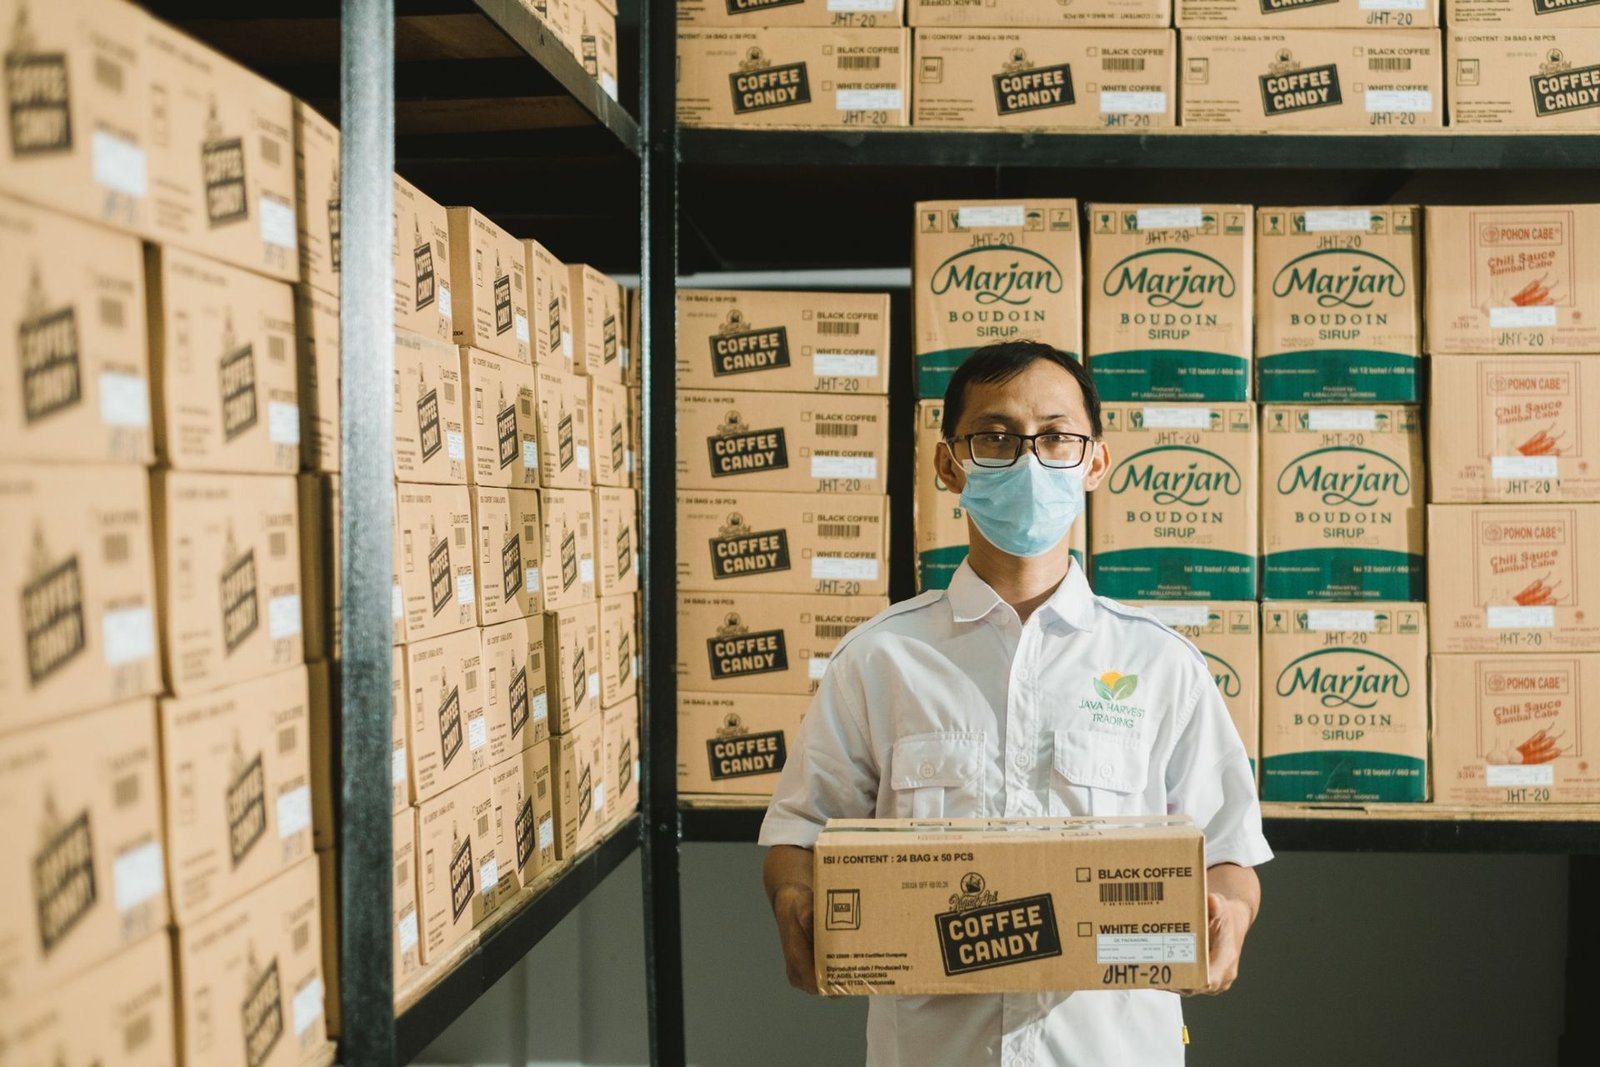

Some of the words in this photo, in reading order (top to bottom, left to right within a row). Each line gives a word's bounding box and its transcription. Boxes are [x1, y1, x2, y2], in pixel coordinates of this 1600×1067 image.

[831, 13, 876, 27] JHT-20
[1367, 11, 1413, 25] JHT-20
[736, 69, 801, 92] COFFEE
[1000, 70, 1065, 93] COFFEE
[1267, 70, 1332, 94] COFFEE
[1538, 70, 1600, 94] COFFEE
[743, 87, 799, 108] CANDY
[1007, 88, 1062, 109] CANDY
[1273, 88, 1329, 110] CANDY
[1545, 88, 1599, 110] CANDY
[842, 111, 888, 125] JHT-20
[1370, 112, 1416, 126] JHT-20
[970, 232, 1014, 247] JHT-20
[1316, 234, 1362, 248] JHT-20
[1501, 228, 1530, 240] POHON
[1532, 228, 1554, 240] CABE
[1488, 254, 1514, 270] Chili
[1518, 250, 1556, 262] Sauce
[1528, 260, 1552, 270] Cabe
[931, 260, 1062, 305] Marjan
[1103, 265, 1236, 309] Marjan
[1272, 265, 1406, 308] Marjan
[948, 310, 1046, 322] BOUDOIN
[1120, 313, 1218, 326] BOUDOIN
[1291, 313, 1388, 325] BOUDOIN
[976, 326, 1018, 337] SIRUP
[1148, 329, 1190, 340] SIRUP
[1318, 329, 1361, 340] SIRUP
[717, 333, 780, 354] COFFEE
[723, 350, 778, 371] CANDY
[814, 378, 860, 391] JHT-20
[1508, 378, 1537, 390] POHON
[1538, 378, 1561, 390] CABE
[1495, 404, 1521, 418] Chili
[1526, 401, 1562, 412] Sauce
[715, 434, 778, 455] COFFEE
[720, 452, 776, 472] CANDY
[816, 478, 862, 492] JHT-20
[1108, 462, 1242, 506] Marjan
[1277, 463, 1410, 507] Marjan
[1126, 511, 1223, 524] BOUDOIN
[1294, 512, 1392, 524] BOUDOIN
[1154, 527, 1196, 538] SIRUP
[1323, 528, 1365, 539] SIRUP
[1504, 527, 1532, 539] POHON
[1534, 526, 1556, 539] CABE
[716, 536, 780, 557] COFFEE
[722, 553, 778, 574] CANDY
[1490, 553, 1517, 568] Chili
[1521, 550, 1558, 562] Sauce
[816, 580, 860, 594] JHT-20
[714, 636, 778, 657] COFFEE
[1322, 632, 1368, 646] JHT-20
[720, 654, 775, 674] CANDY
[1276, 664, 1410, 709] Marjan
[1506, 677, 1536, 689] POHON
[1538, 676, 1560, 689] CABE
[1079, 700, 1103, 710] JAVA
[1106, 702, 1146, 720] HARVEST
[1494, 704, 1520, 718] Chili
[1524, 700, 1562, 712] Sauce
[1093, 713, 1134, 728] TRADING
[1294, 714, 1392, 726] BOUDOIN
[1322, 730, 1364, 741] SIRUP
[714, 737, 778, 758] COFFEE
[720, 754, 775, 774] CANDY
[824, 856, 835, 864] ISI
[843, 855, 888, 864] CONTENT
[896, 854, 908, 863] 24
[910, 854, 931, 863] BAG
[941, 853, 952, 862] 50
[954, 852, 974, 862] PCS
[1098, 868, 1140, 880] BLACK
[1143, 867, 1192, 878] COFFEE
[948, 904, 1042, 941] COFFEE
[1099, 924, 1139, 934] WHITE
[1142, 922, 1191, 934] COFFEE
[958, 932, 1038, 964] CANDY
[1102, 964, 1172, 985] JHT-20
